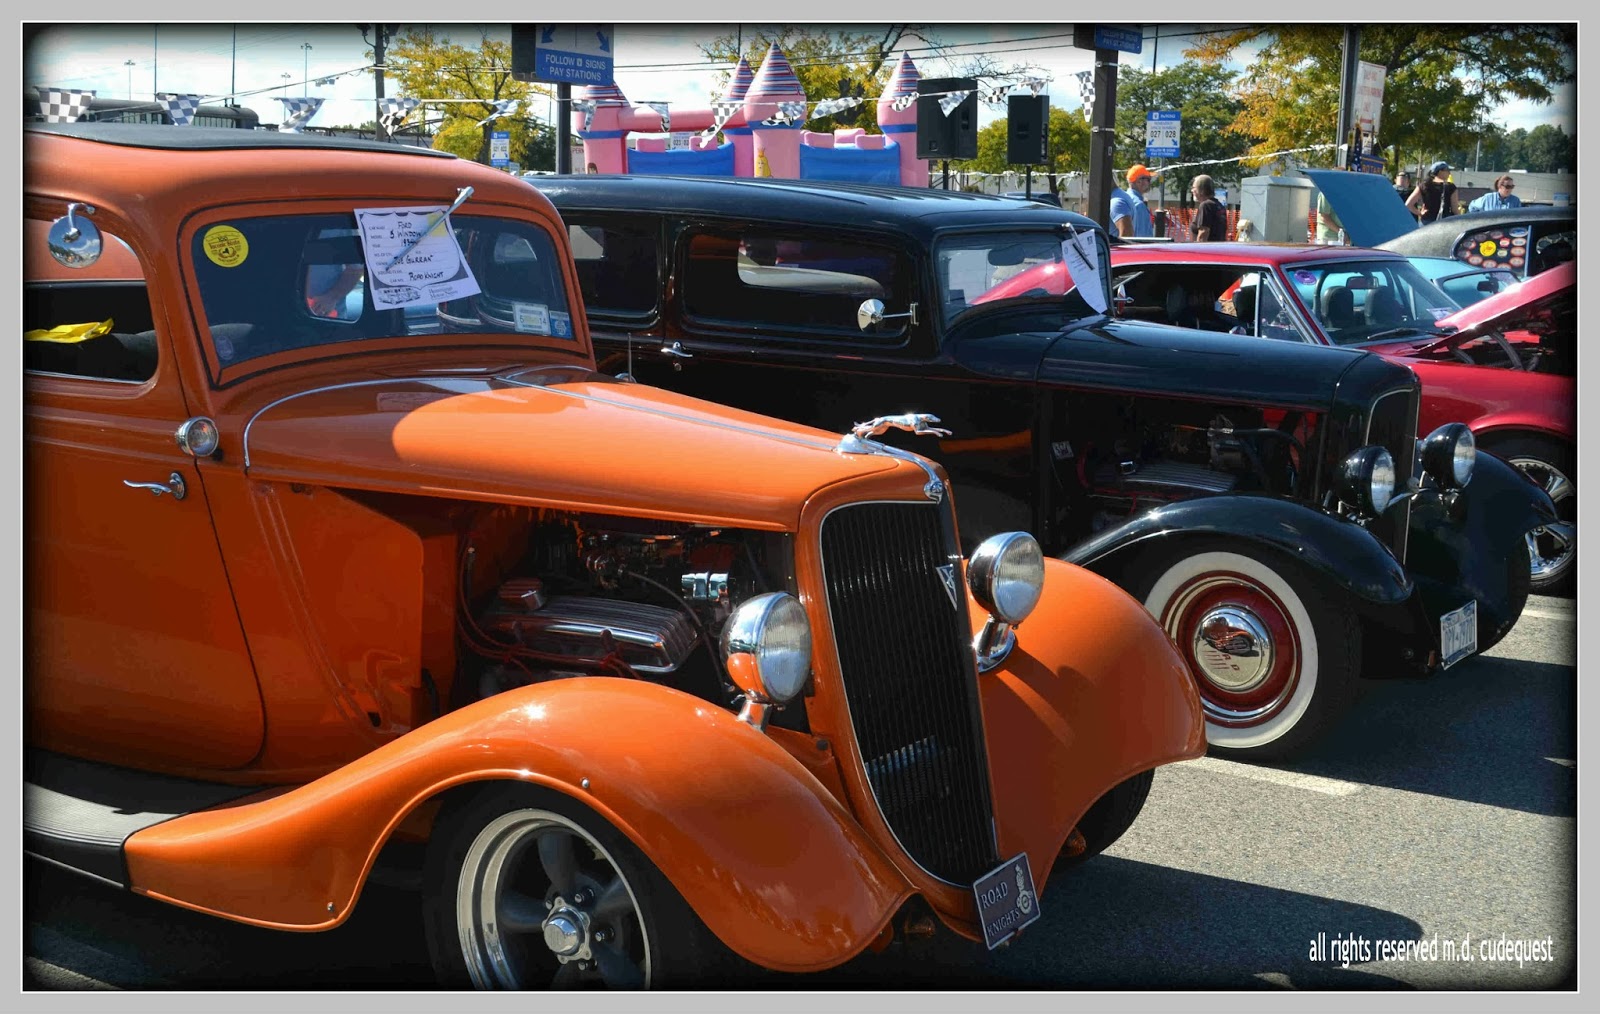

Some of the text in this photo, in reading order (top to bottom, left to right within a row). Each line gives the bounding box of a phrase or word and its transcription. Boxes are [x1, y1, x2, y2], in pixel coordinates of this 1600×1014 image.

[546, 54, 606, 70] FOLLOW SIGNS
[549, 67, 602, 81] PAY STATIONS
[1150, 130, 1177, 138] 027 028
[397, 221, 412, 229] FORD
[980, 881, 1008, 909] ROAD
[986, 908, 1021, 937] KNIGHTS
